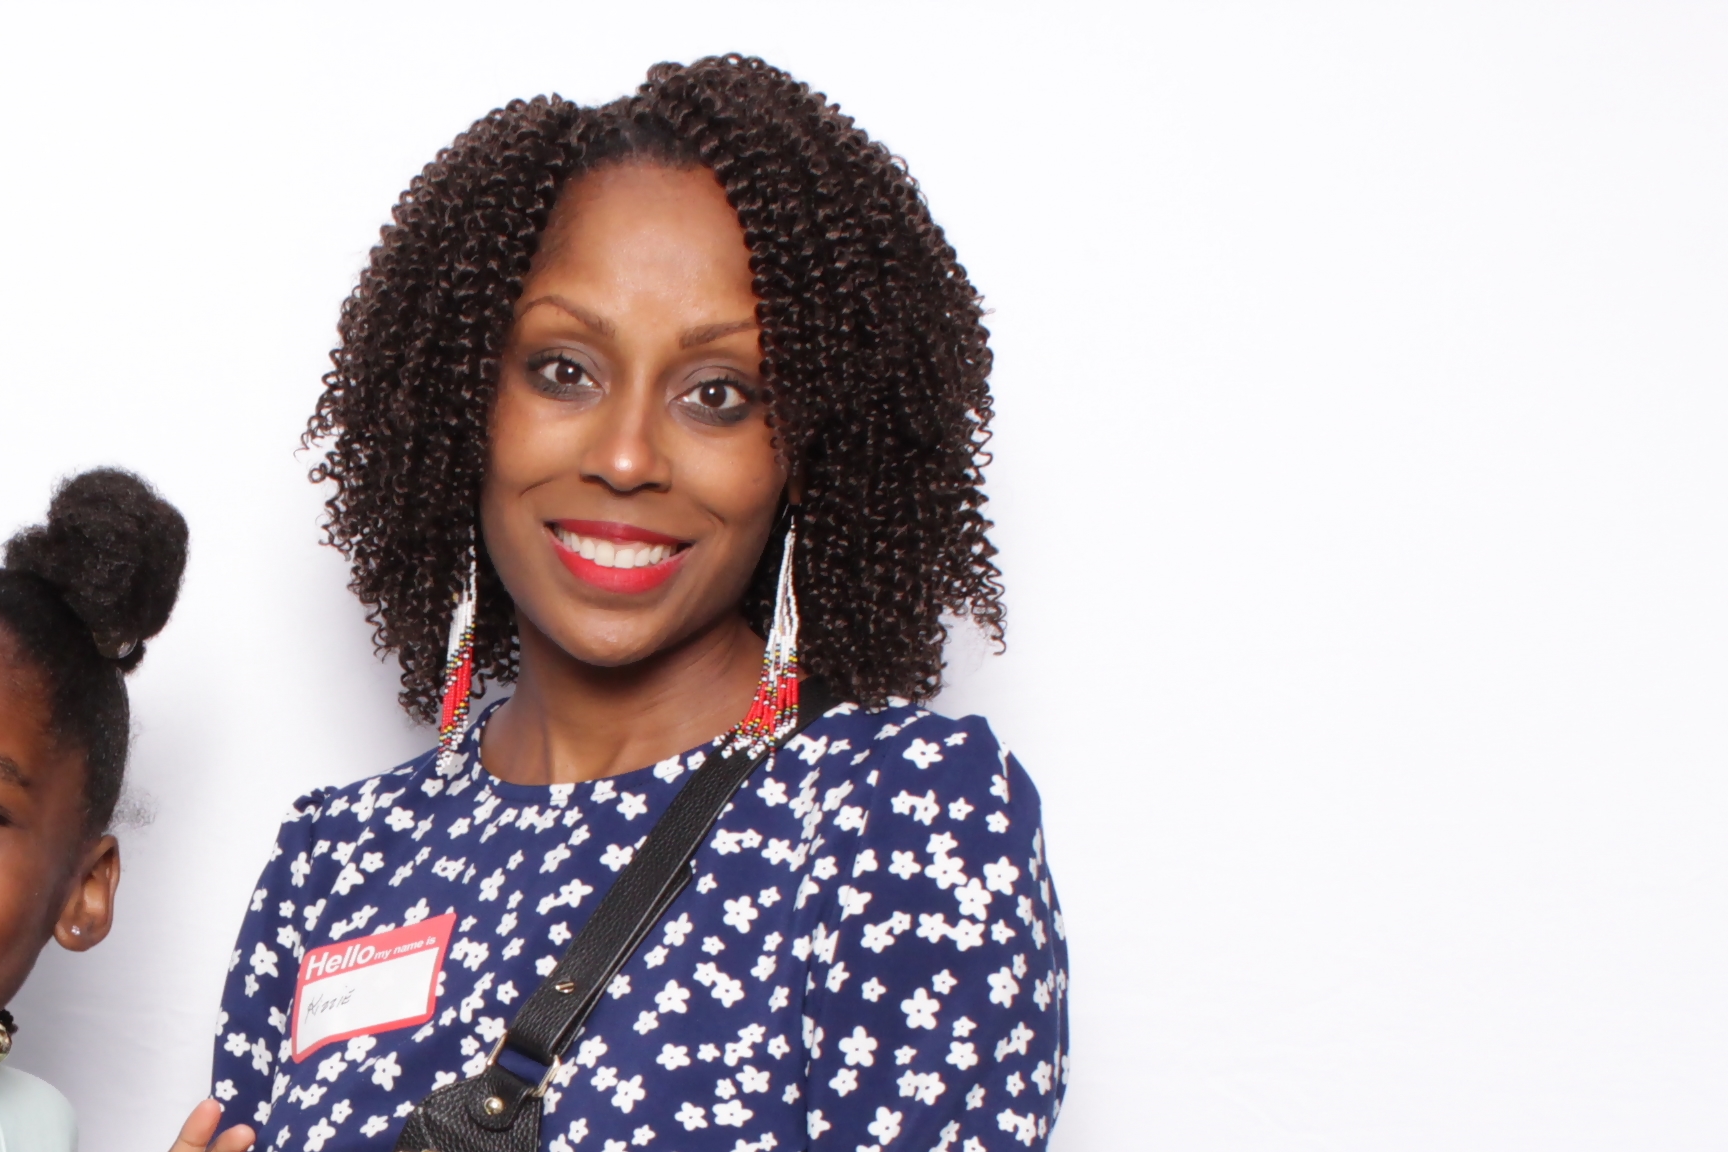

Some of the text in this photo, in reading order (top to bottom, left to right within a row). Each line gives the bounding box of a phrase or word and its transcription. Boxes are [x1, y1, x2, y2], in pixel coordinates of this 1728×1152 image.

[305, 936, 436, 980] Hello my name is
